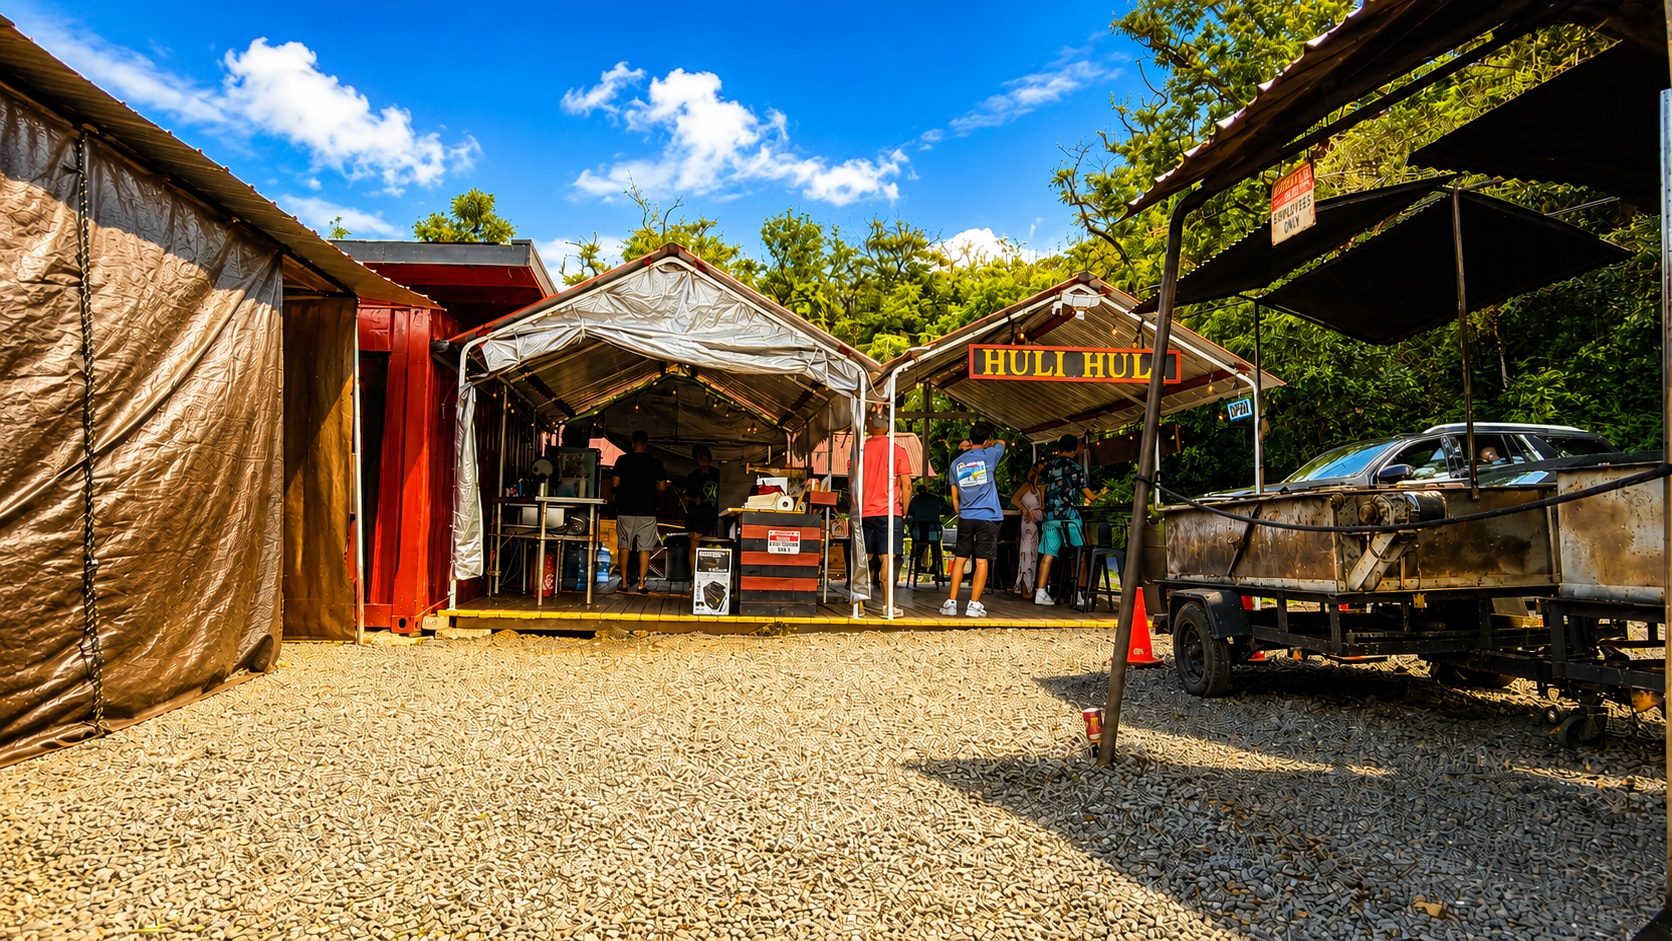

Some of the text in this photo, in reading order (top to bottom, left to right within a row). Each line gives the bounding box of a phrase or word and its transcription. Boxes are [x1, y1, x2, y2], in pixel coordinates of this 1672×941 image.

[1274, 194, 1311, 224] EMPLOYEES
[1284, 215, 1300, 234] ONLY
[983, 349, 1166, 381] HULI HUL
